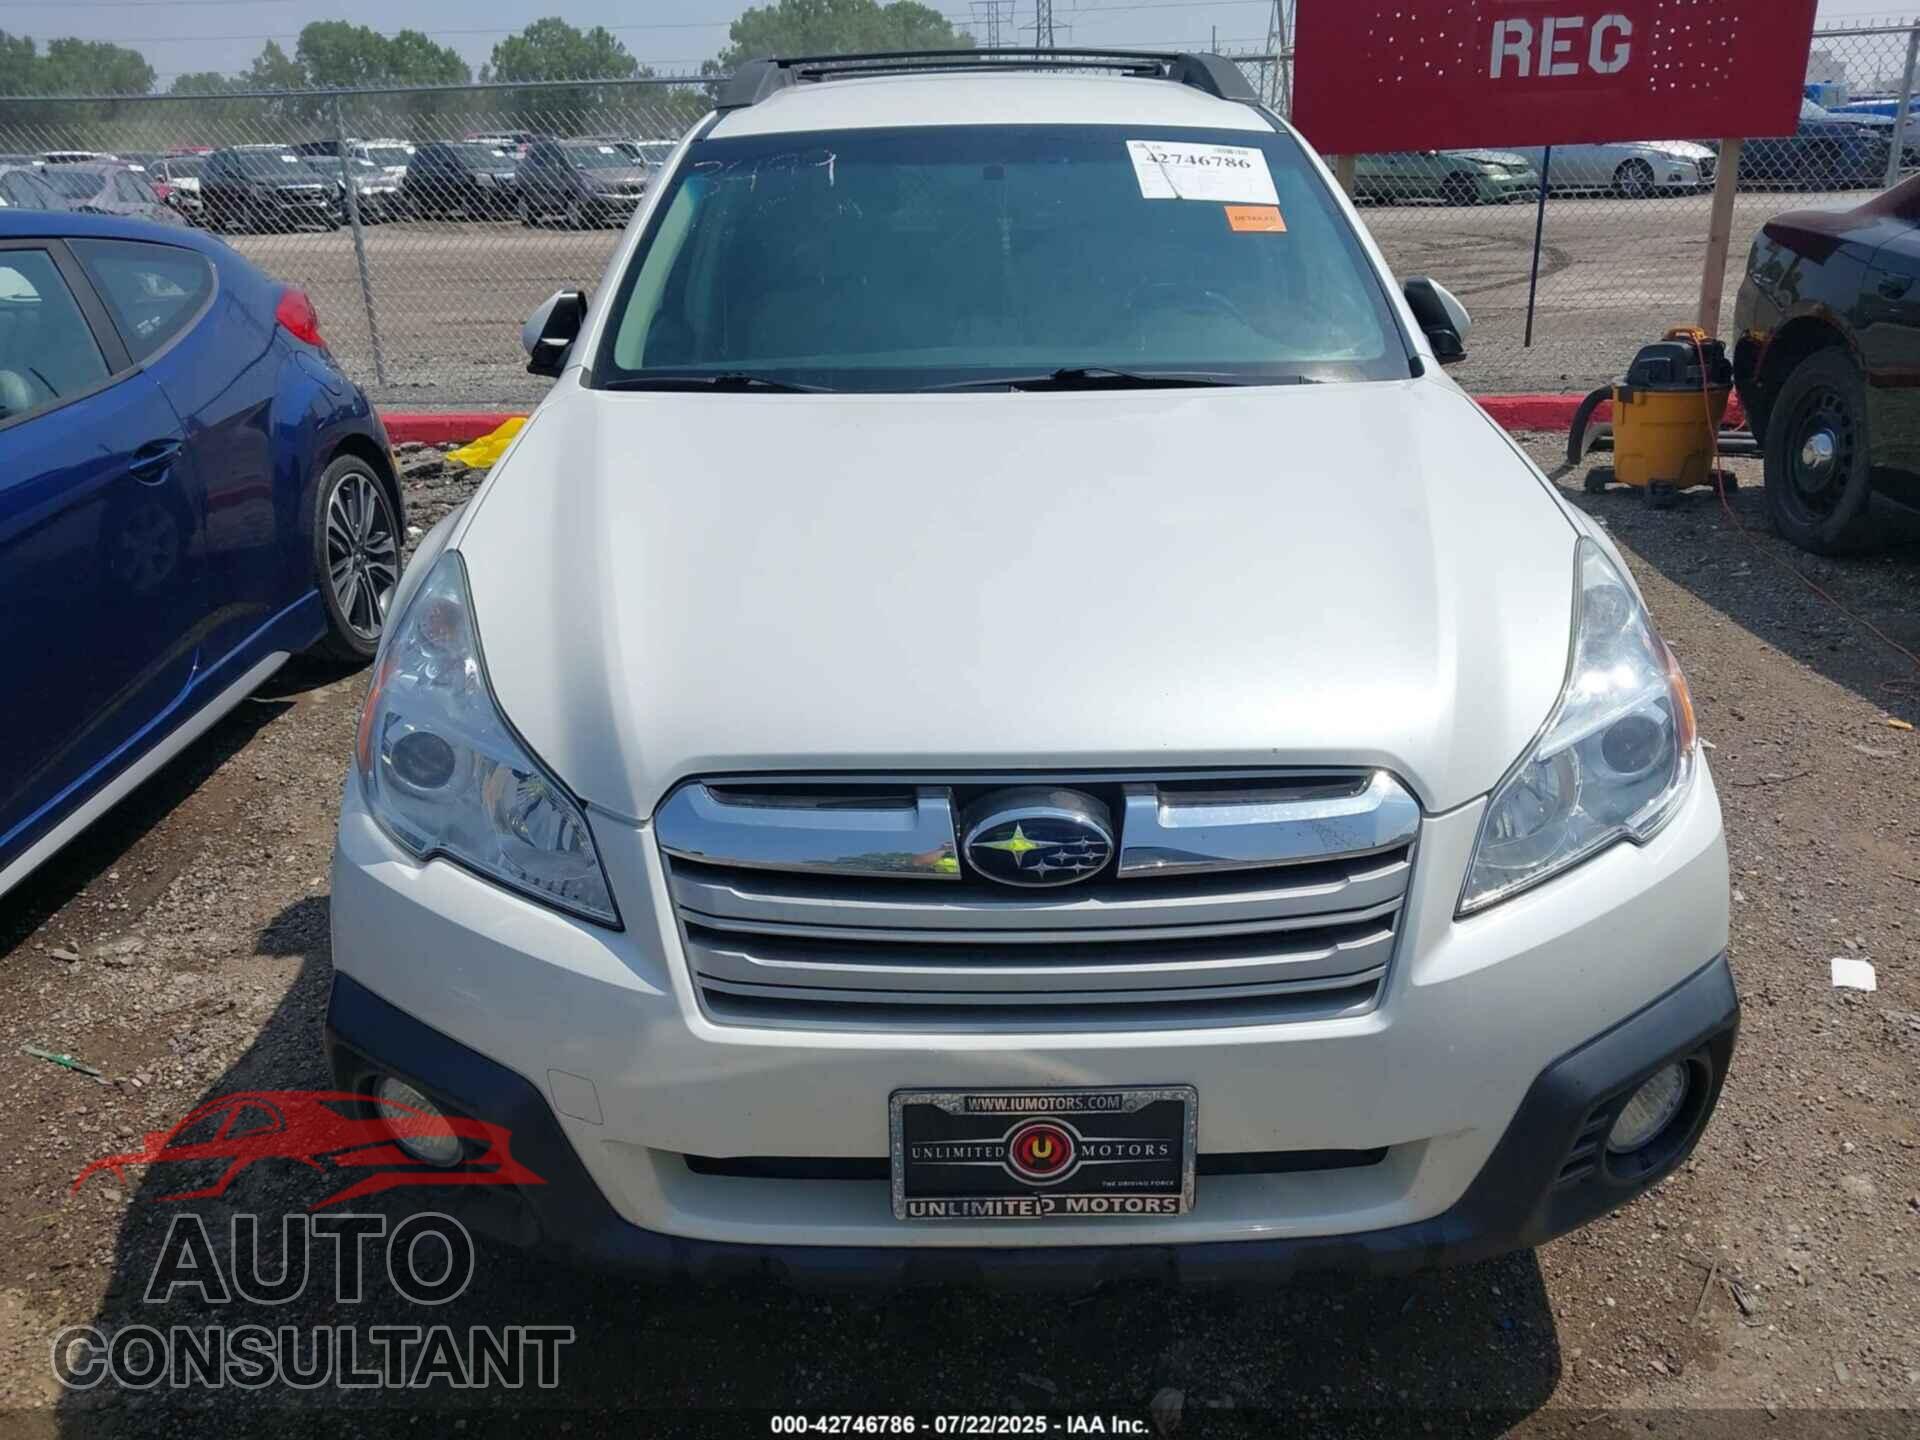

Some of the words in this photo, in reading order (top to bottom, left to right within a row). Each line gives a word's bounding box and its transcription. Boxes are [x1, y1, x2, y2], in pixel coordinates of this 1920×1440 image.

[1489, 14, 1633, 80] REG
[1146, 152, 1251, 168] 42746786
[967, 1095, 1121, 1111] WWW.IUMOTORS.COM
[911, 1146, 1005, 1159] UNLIMITED
[1081, 1143, 1169, 1157] MOTORS
[909, 1199, 1056, 1217] UNLIMITED
[1065, 1198, 1176, 1213] MOTORS
